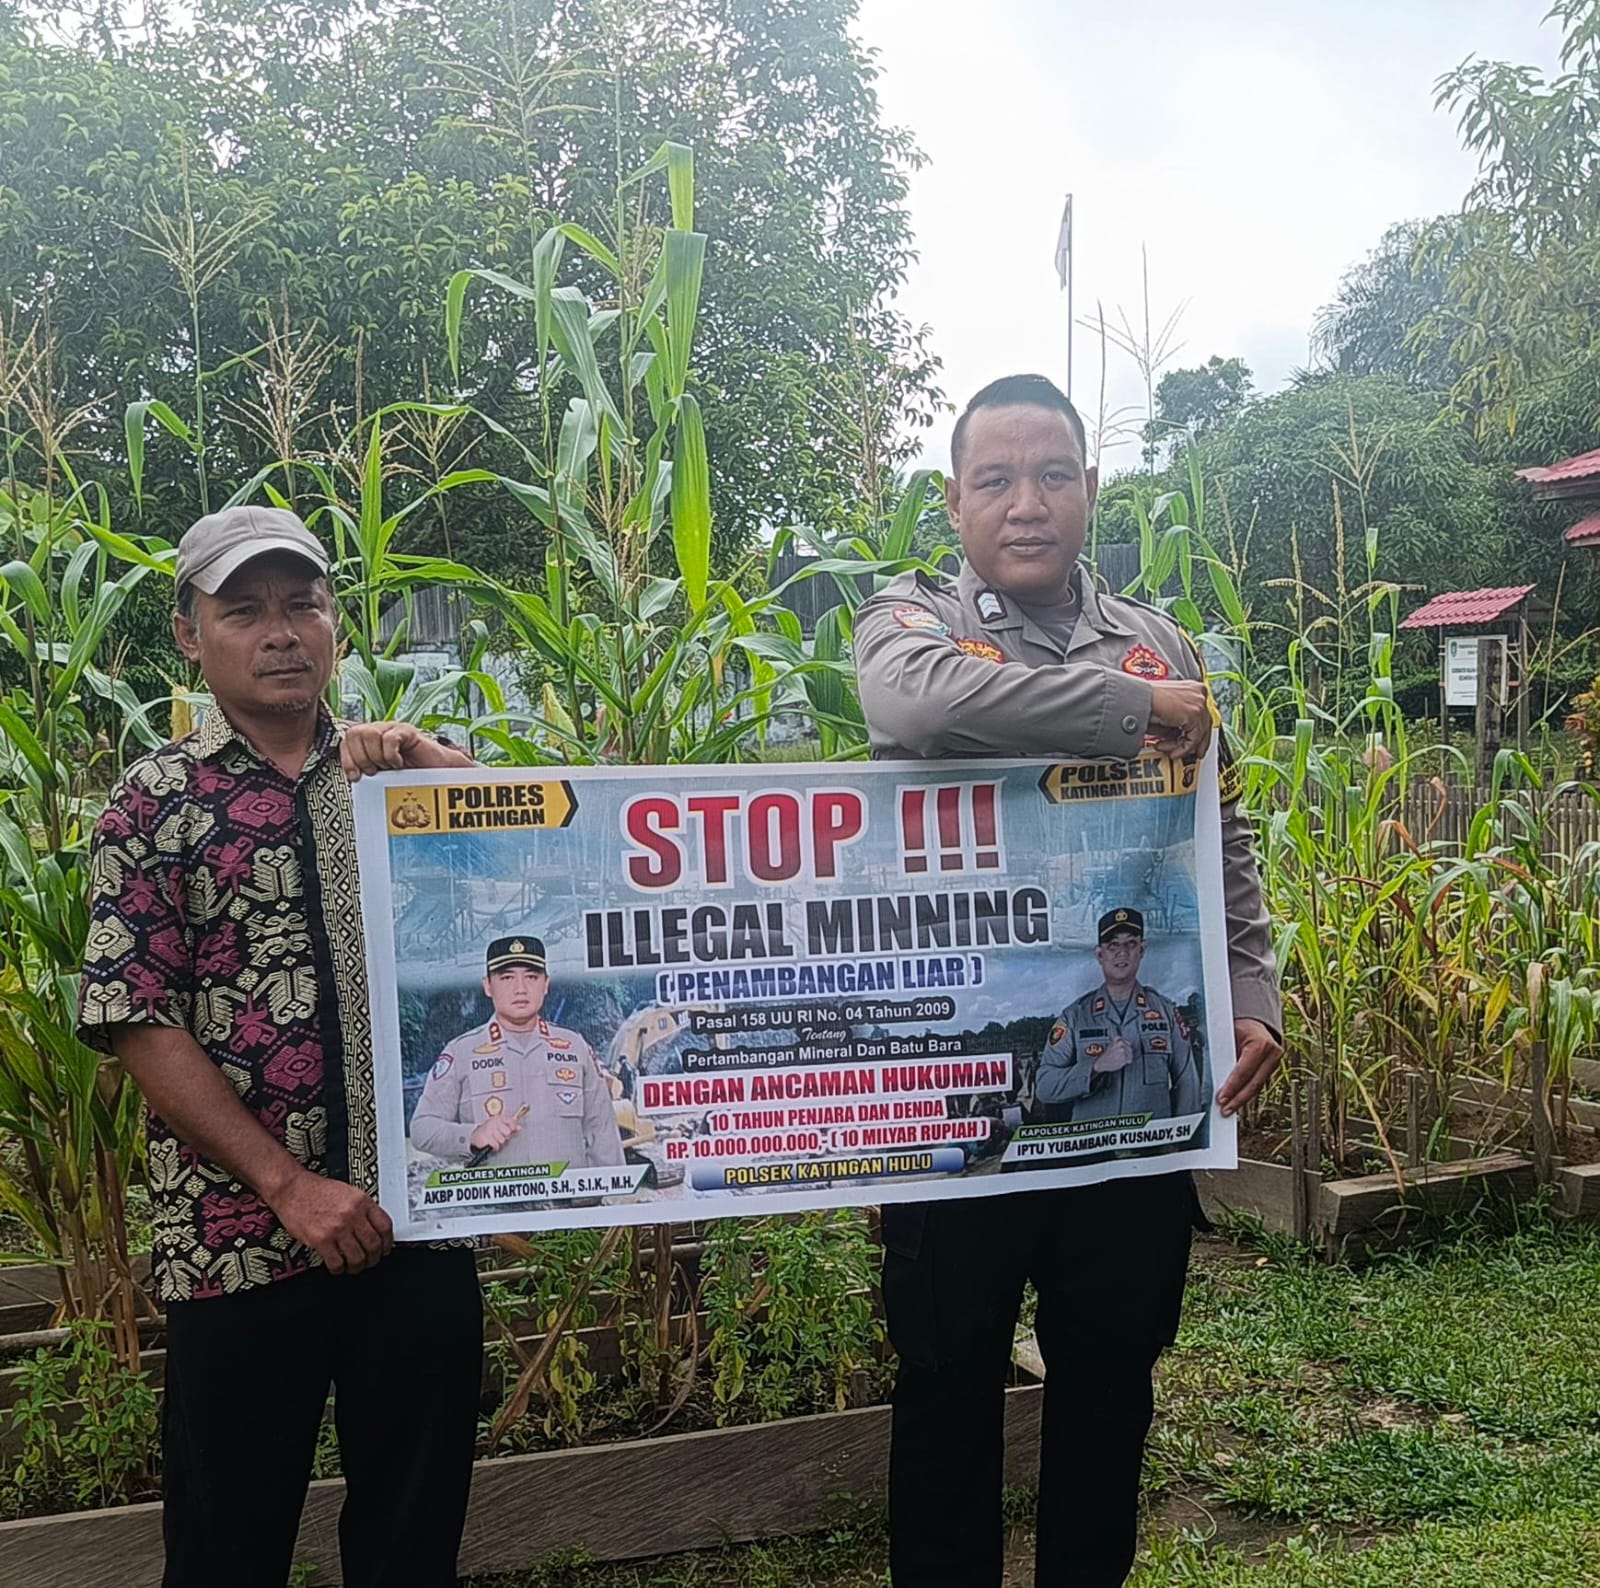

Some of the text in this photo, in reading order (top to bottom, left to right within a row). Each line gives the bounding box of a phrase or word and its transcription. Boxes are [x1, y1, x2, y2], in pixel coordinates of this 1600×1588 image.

[1060, 758, 1163, 784] POLSEK
[447, 784, 545, 809] POLRES
[1060, 780, 1165, 800] KATINGAN HULU
[448, 809, 545, 829] KATINGAN
[625, 783, 1000, 888] STOP !!!
[585, 887, 1049, 968] ILLEGAL MINNING
[696, 1001, 950, 1029] Pasal 158 UU RI No. 04 Tahun 2009
[801, 1026, 847, 1042] Tentang
[471, 1057, 505, 1071] DODIK
[547, 1052, 578, 1063] POLRI
[687, 1038, 962, 1068] Pertambangan Mineral Dan Batu Bara
[643, 1060, 1007, 1108] DENGAN ANCAMAN HUKUMAN
[710, 1100, 944, 1132] 10 TAHUN PENJARA DAN DENDA
[1020, 1115, 1145, 1138] KAPOLSEK KATINGAN HULU
[666, 1142, 690, 1160] RP.
[862, 1124, 918, 1146] MILYAR
[1016, 1124, 1191, 1157] IPTU YUBAMBANG KUSNADY, SH
[440, 1165, 549, 1183] KAPOLRES KATINGAN
[725, 1154, 932, 1185] POLSEK KATINGAN HULU
[424, 1189, 453, 1205] AKBP
[456, 1186, 491, 1201] DODIK
[493, 1182, 549, 1199] HARTONO,
[611, 1175, 634, 1190] M.H.
